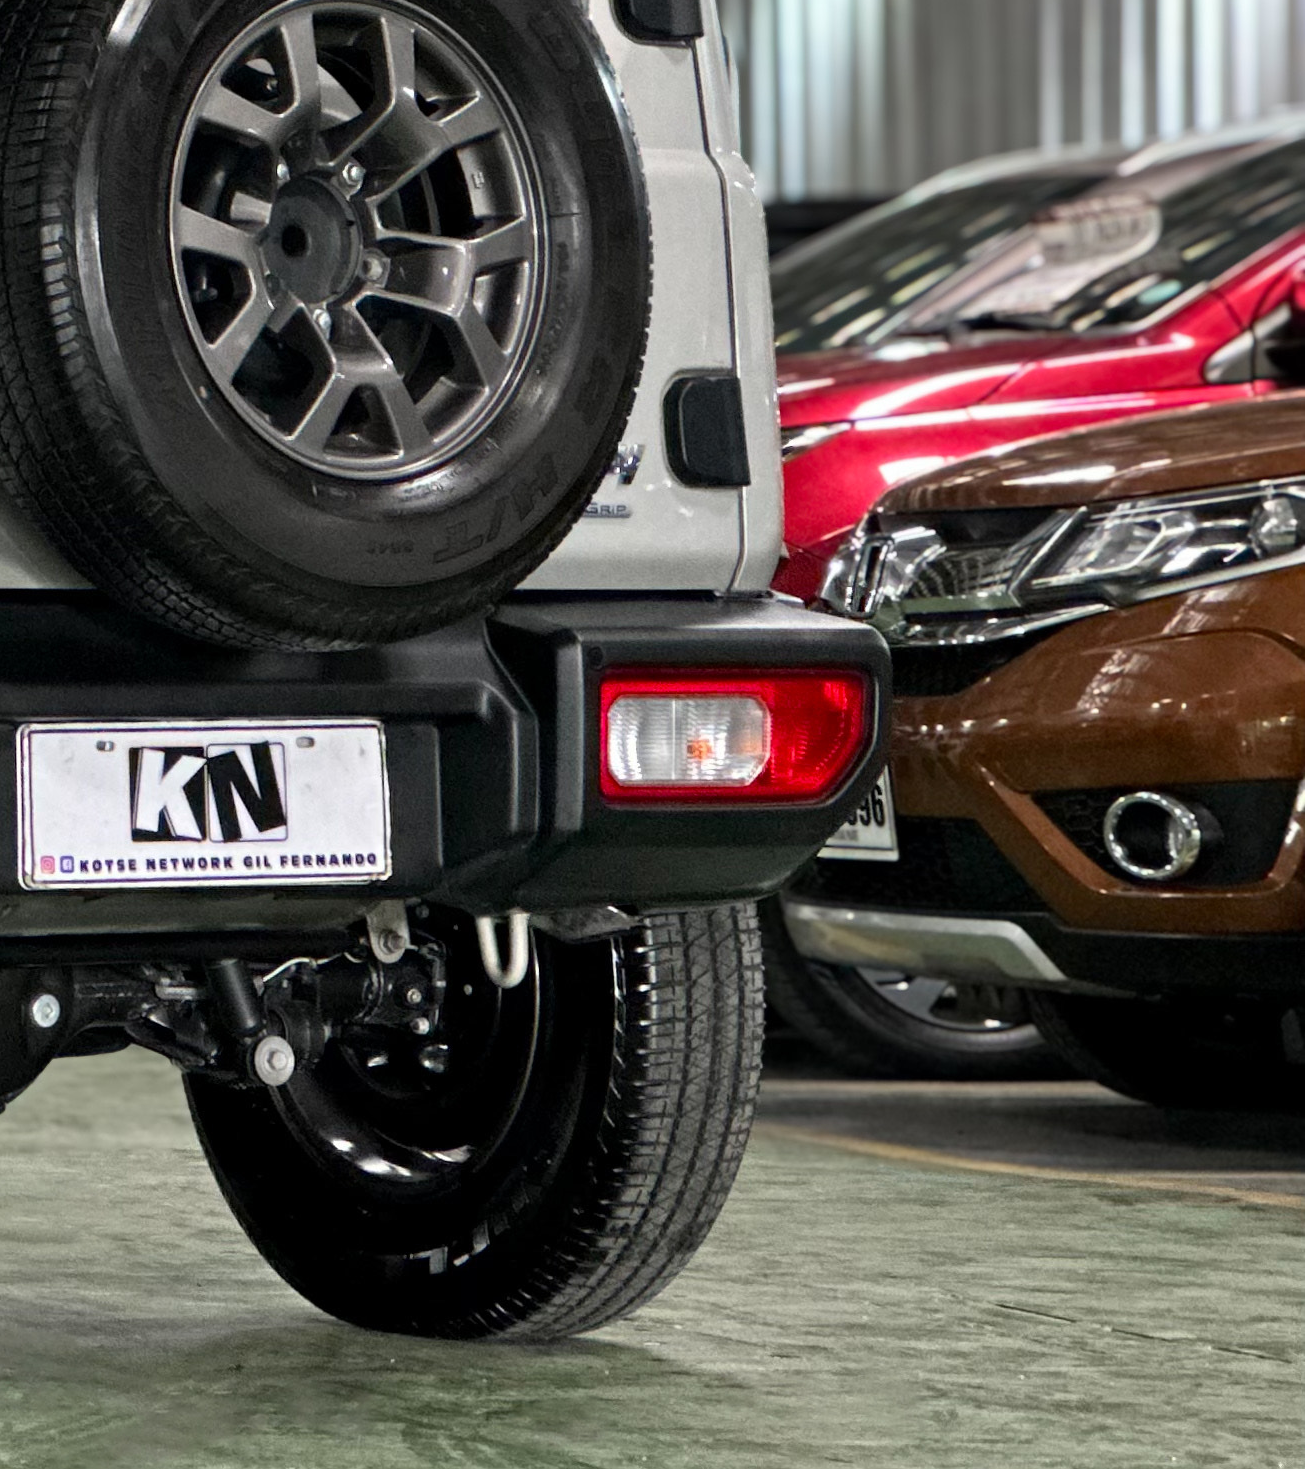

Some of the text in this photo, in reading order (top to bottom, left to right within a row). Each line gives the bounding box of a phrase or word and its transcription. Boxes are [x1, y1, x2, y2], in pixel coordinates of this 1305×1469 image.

[583, 501, 627, 515] GRIP
[130, 740, 288, 843] KN
[79, 852, 378, 873] KOTSE NETWORK GIL FERNANDO
